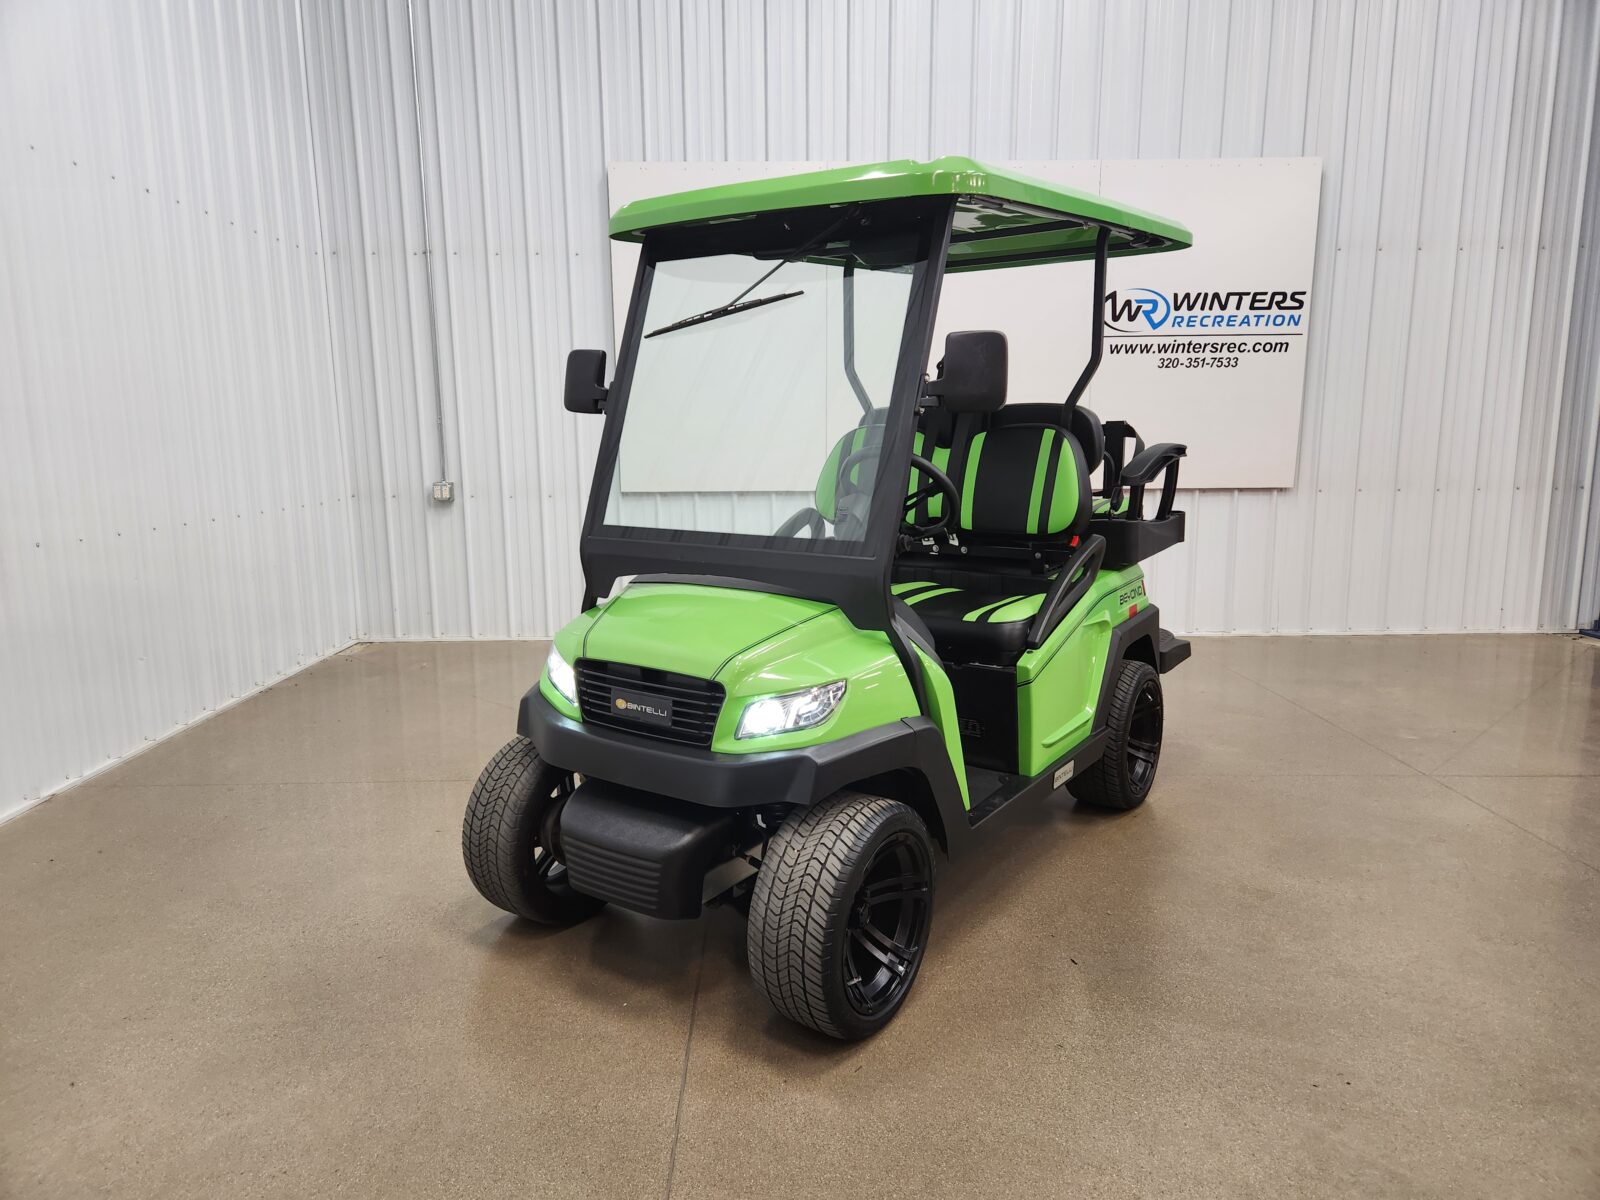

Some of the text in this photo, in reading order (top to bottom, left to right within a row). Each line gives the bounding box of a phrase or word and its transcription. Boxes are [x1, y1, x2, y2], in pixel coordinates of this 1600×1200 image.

[1173, 291, 1307, 311] WINTERS
[1171, 314, 1302, 328] RECREATION
[1109, 339, 1289, 354] www.wintersrec.com
[1157, 357, 1239, 368] 320-351-7533
[1119, 585, 1142, 605] BEYOND
[626, 702, 667, 717] BINTELLI
